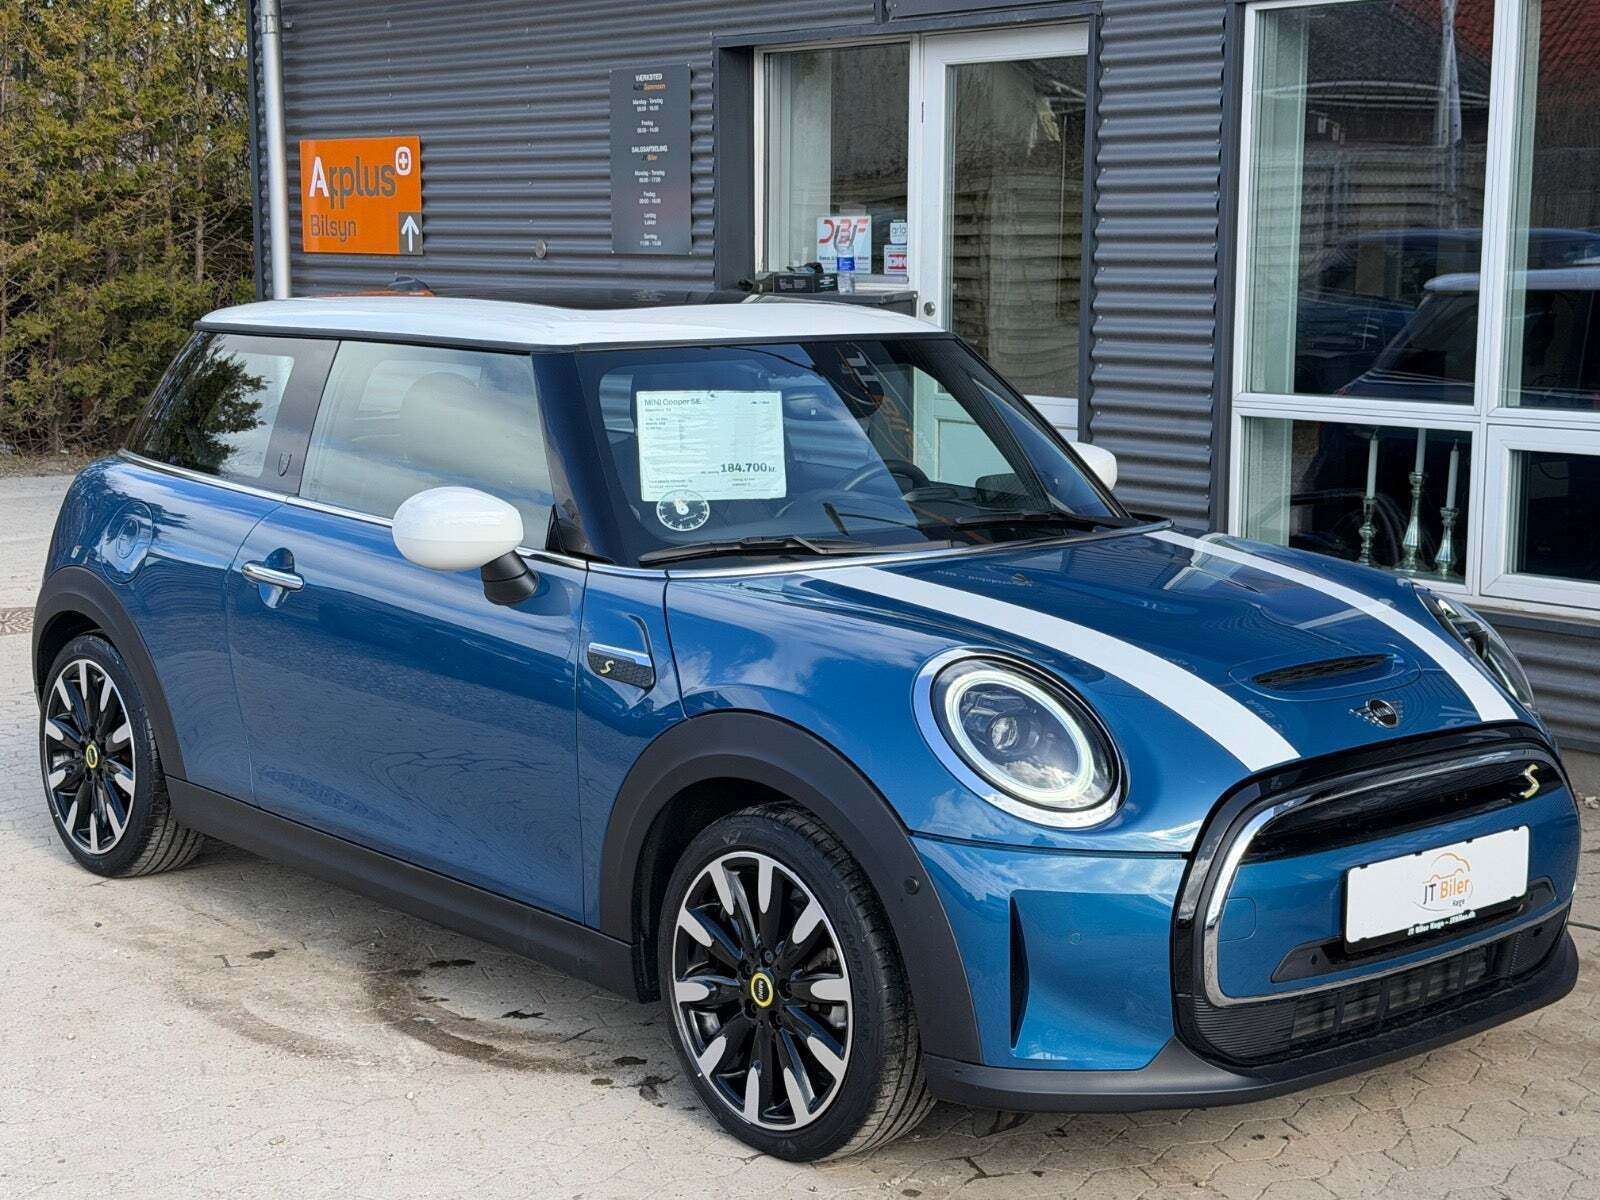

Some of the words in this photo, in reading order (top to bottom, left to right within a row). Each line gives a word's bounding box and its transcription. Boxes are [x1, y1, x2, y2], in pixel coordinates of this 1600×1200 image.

[310, 214, 357, 242] Bilsyn
[662, 398, 690, 406] Cooper
[720, 463, 767, 473] 184.700
[599, 659, 615, 674] S
[1519, 763, 1539, 799] S
[1422, 883, 1437, 904] JT
[1439, 878, 1470, 900] Biler
